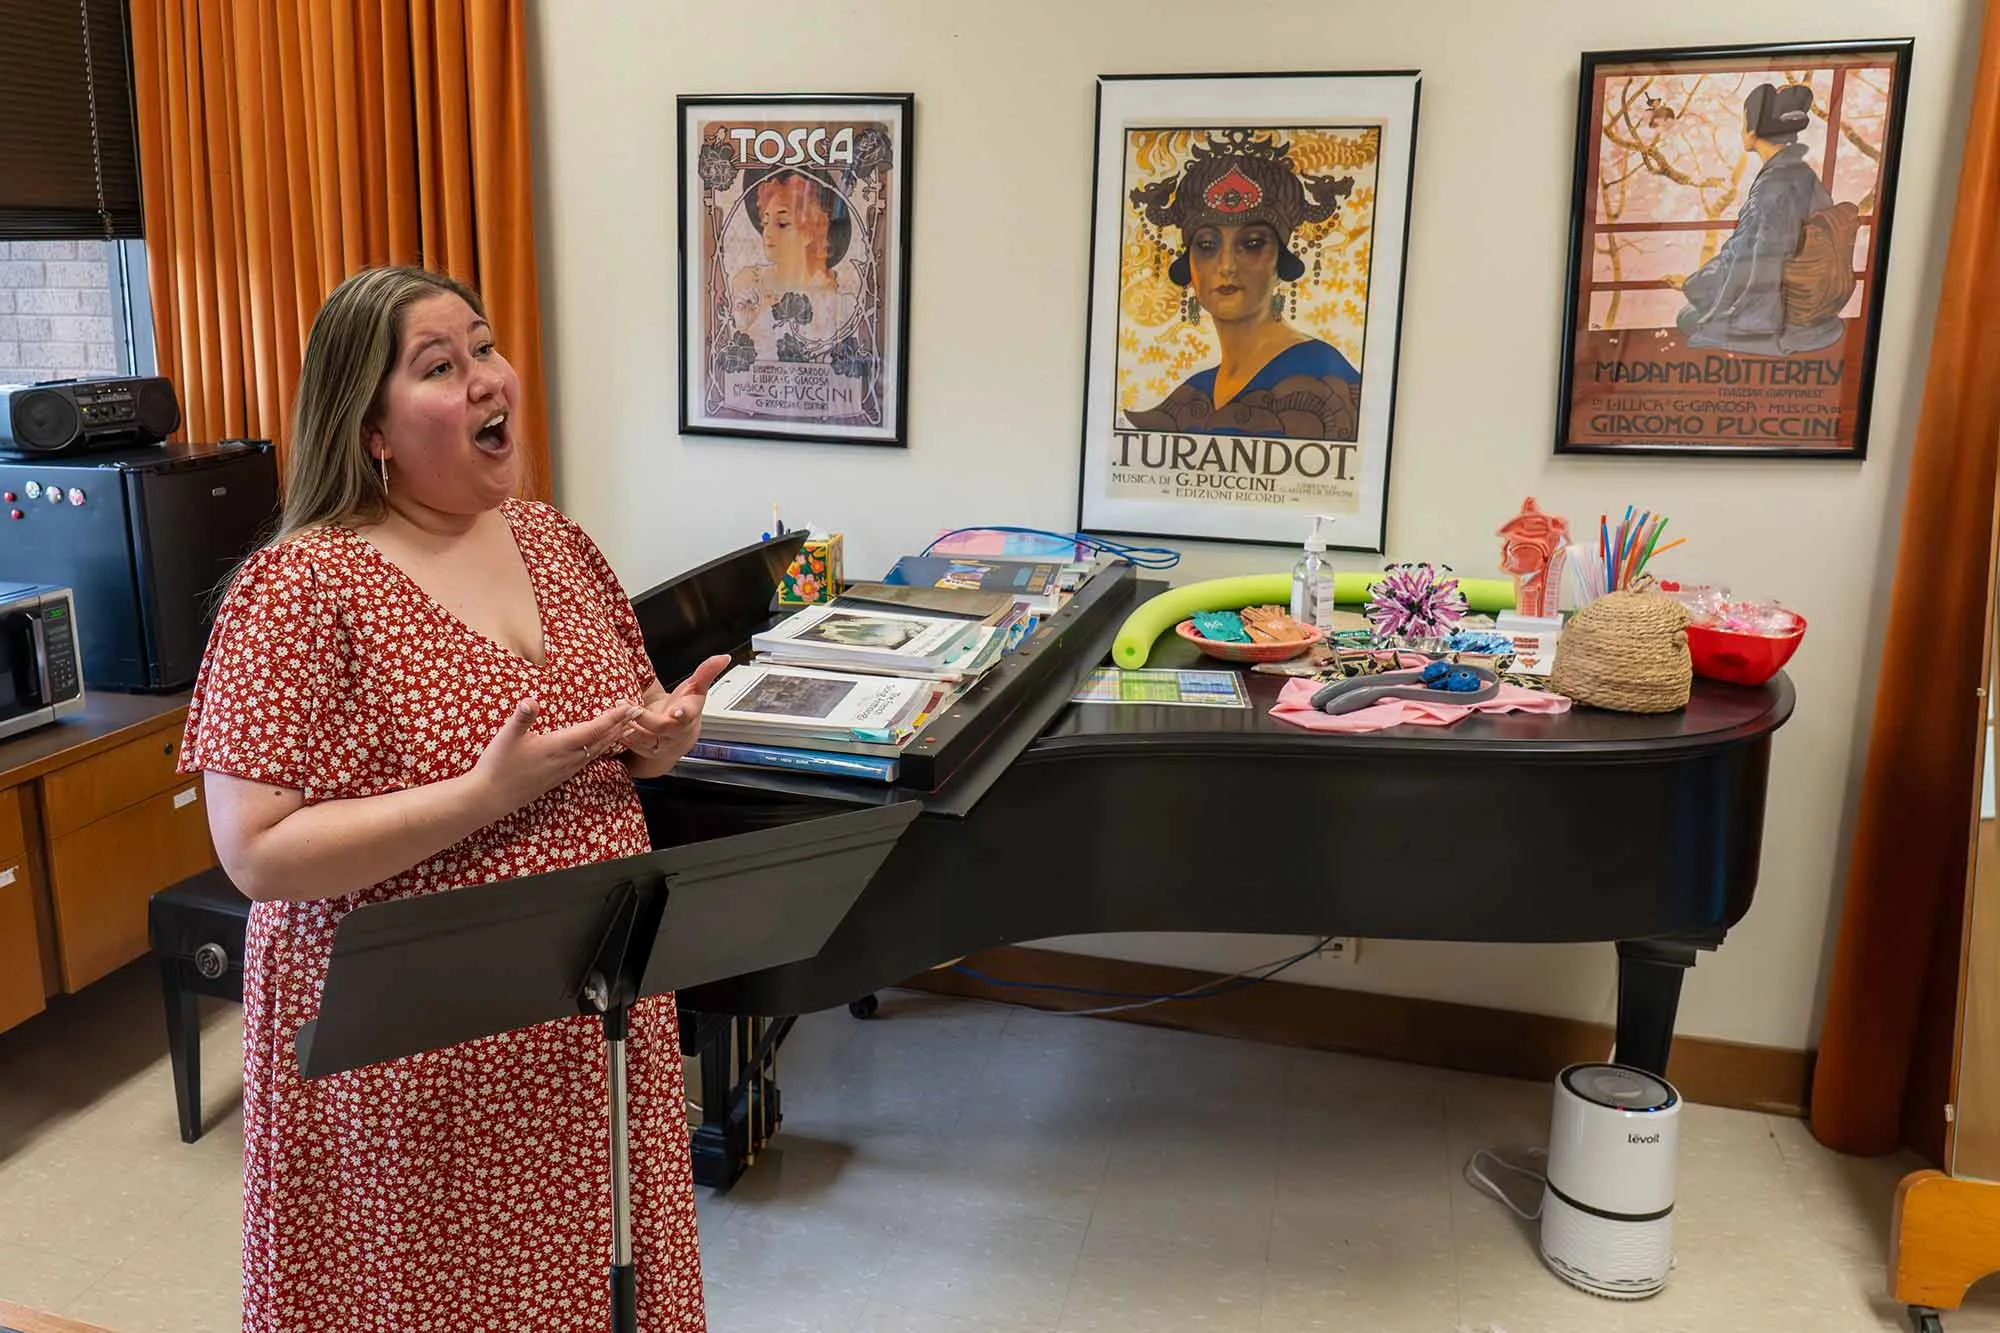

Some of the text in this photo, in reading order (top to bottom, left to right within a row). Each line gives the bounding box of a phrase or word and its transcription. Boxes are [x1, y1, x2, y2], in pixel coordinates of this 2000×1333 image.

[730, 127, 854, 166] TOSCA
[1703, 355, 1844, 385] BUTTERFLY
[1590, 413, 1841, 437] GIACOMO PUCCINI
[1111, 472, 1156, 485] MUSICA
[1159, 475, 1170, 486] DI
[1175, 487, 1233, 501] EDIZIONI
[1235, 490, 1286, 504] RICORDI
